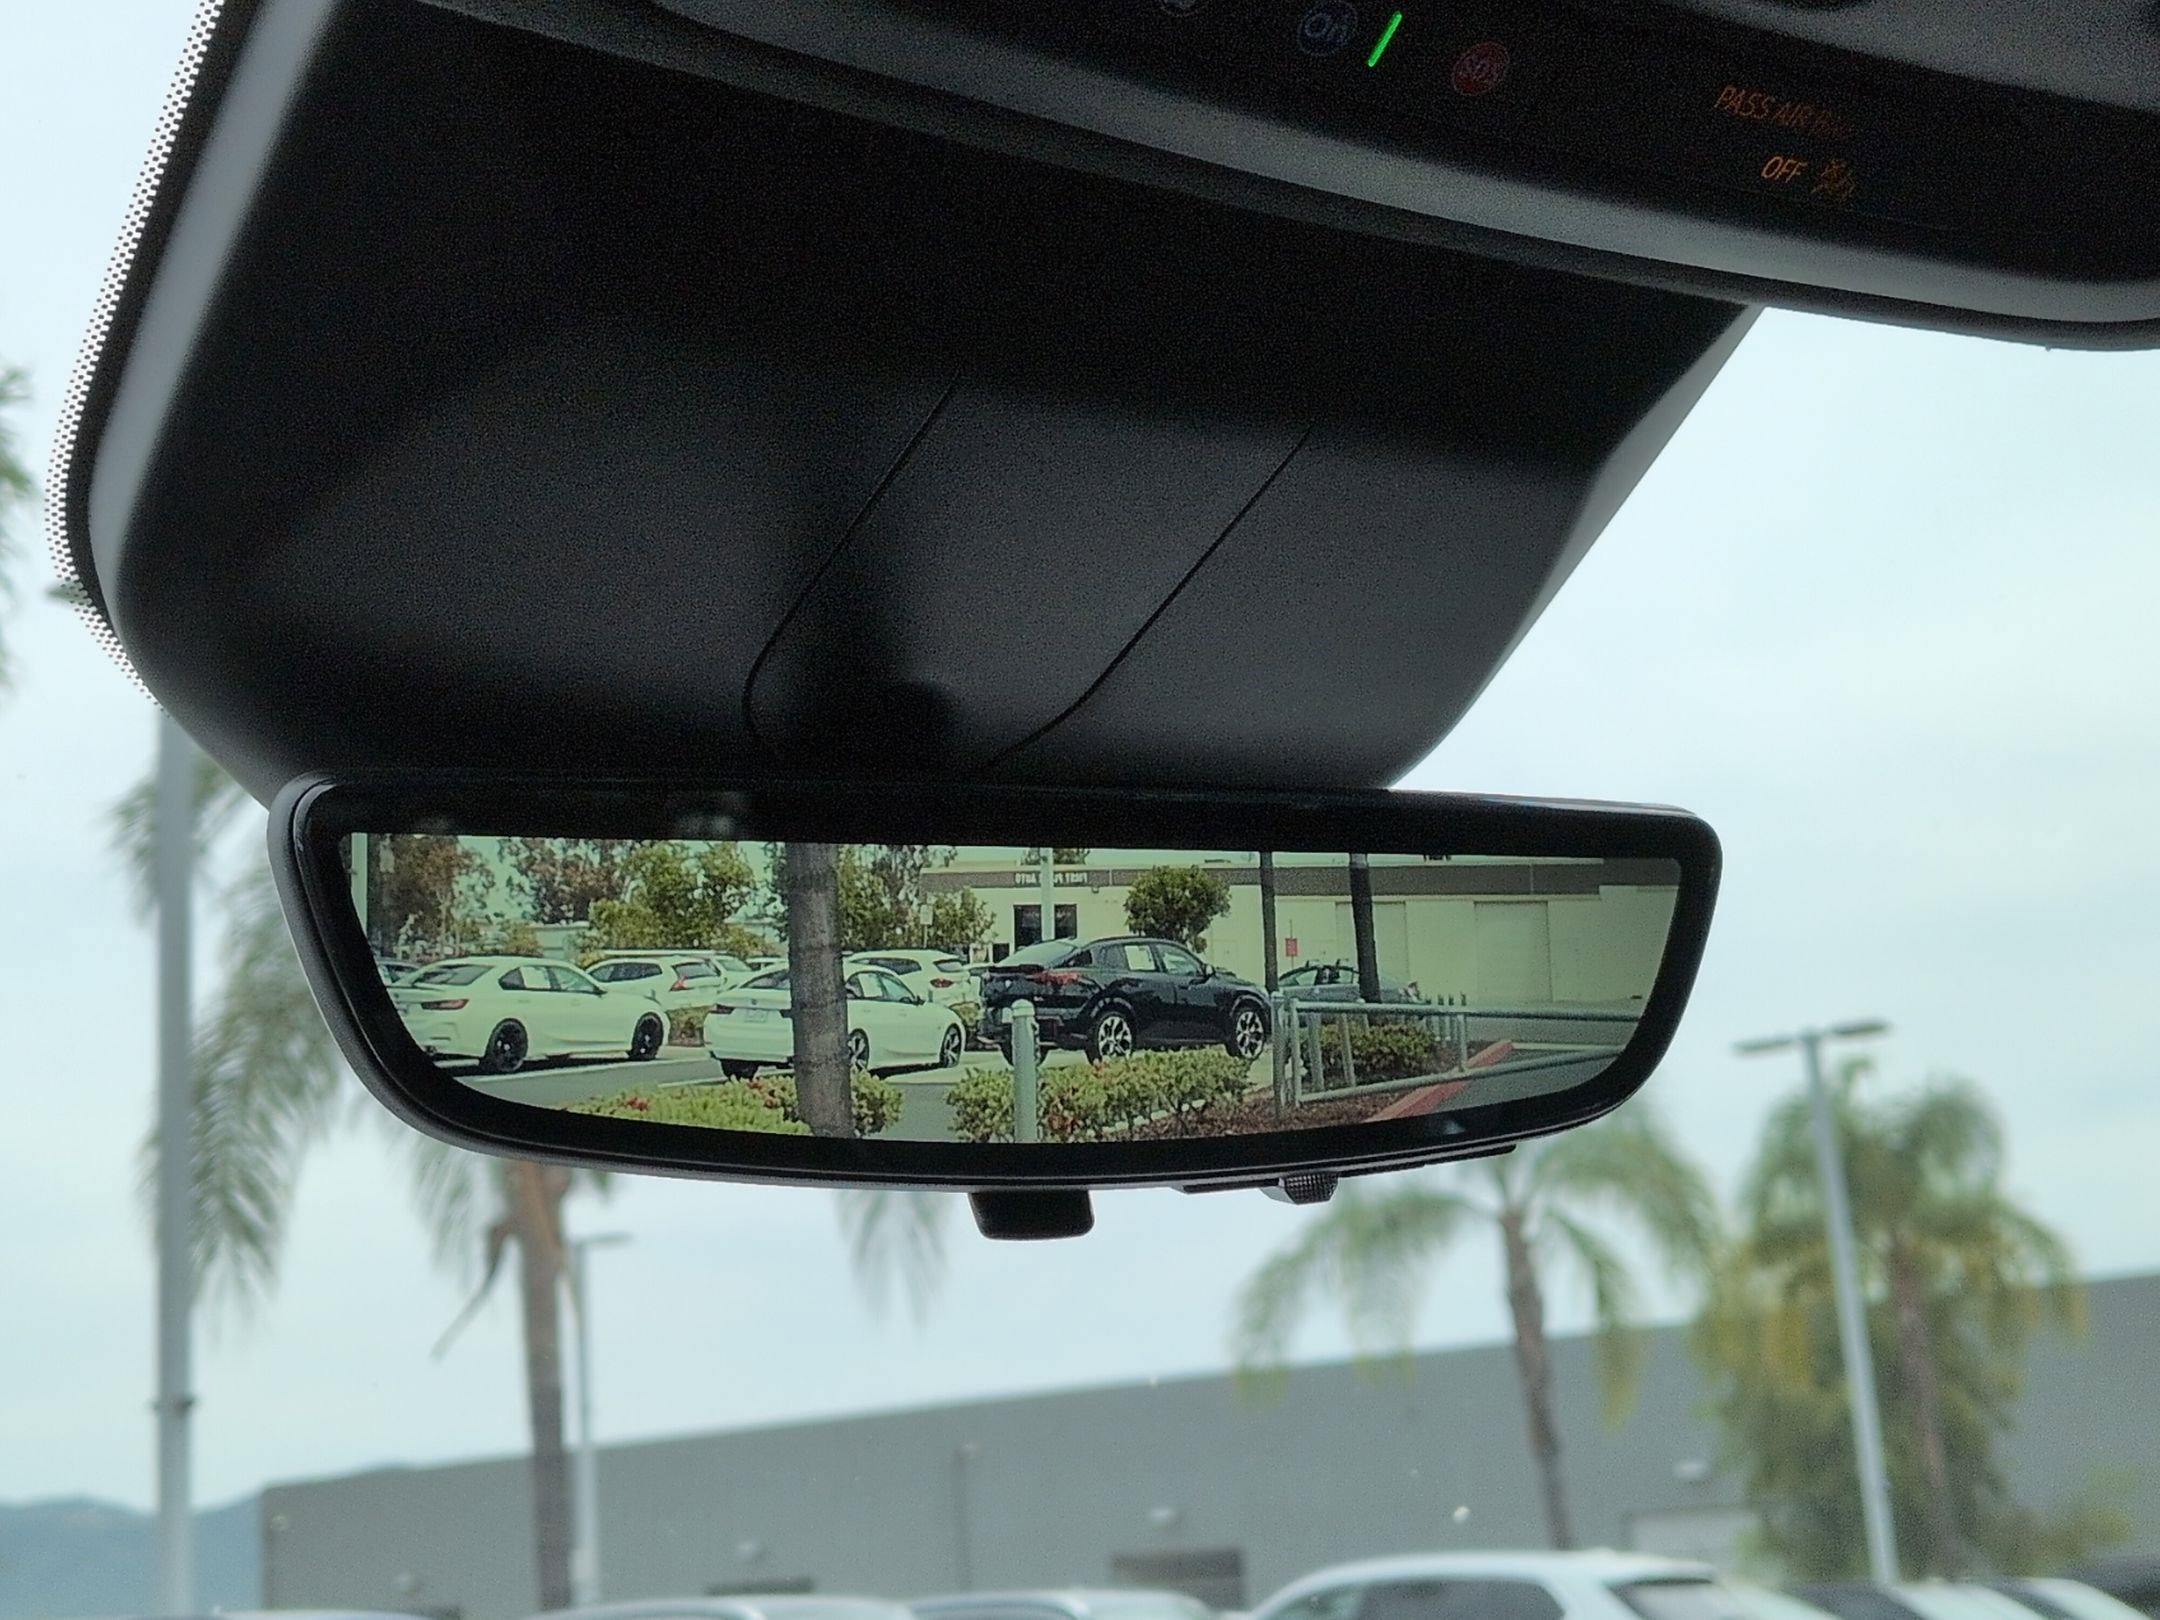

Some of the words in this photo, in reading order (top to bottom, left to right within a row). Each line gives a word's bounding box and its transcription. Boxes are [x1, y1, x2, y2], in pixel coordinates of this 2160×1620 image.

[1457, 53, 1504, 85] SOS
[1713, 84, 1776, 119] PASS
[1773, 101, 1812, 127] AIR
[1761, 155, 1808, 184] OFF
